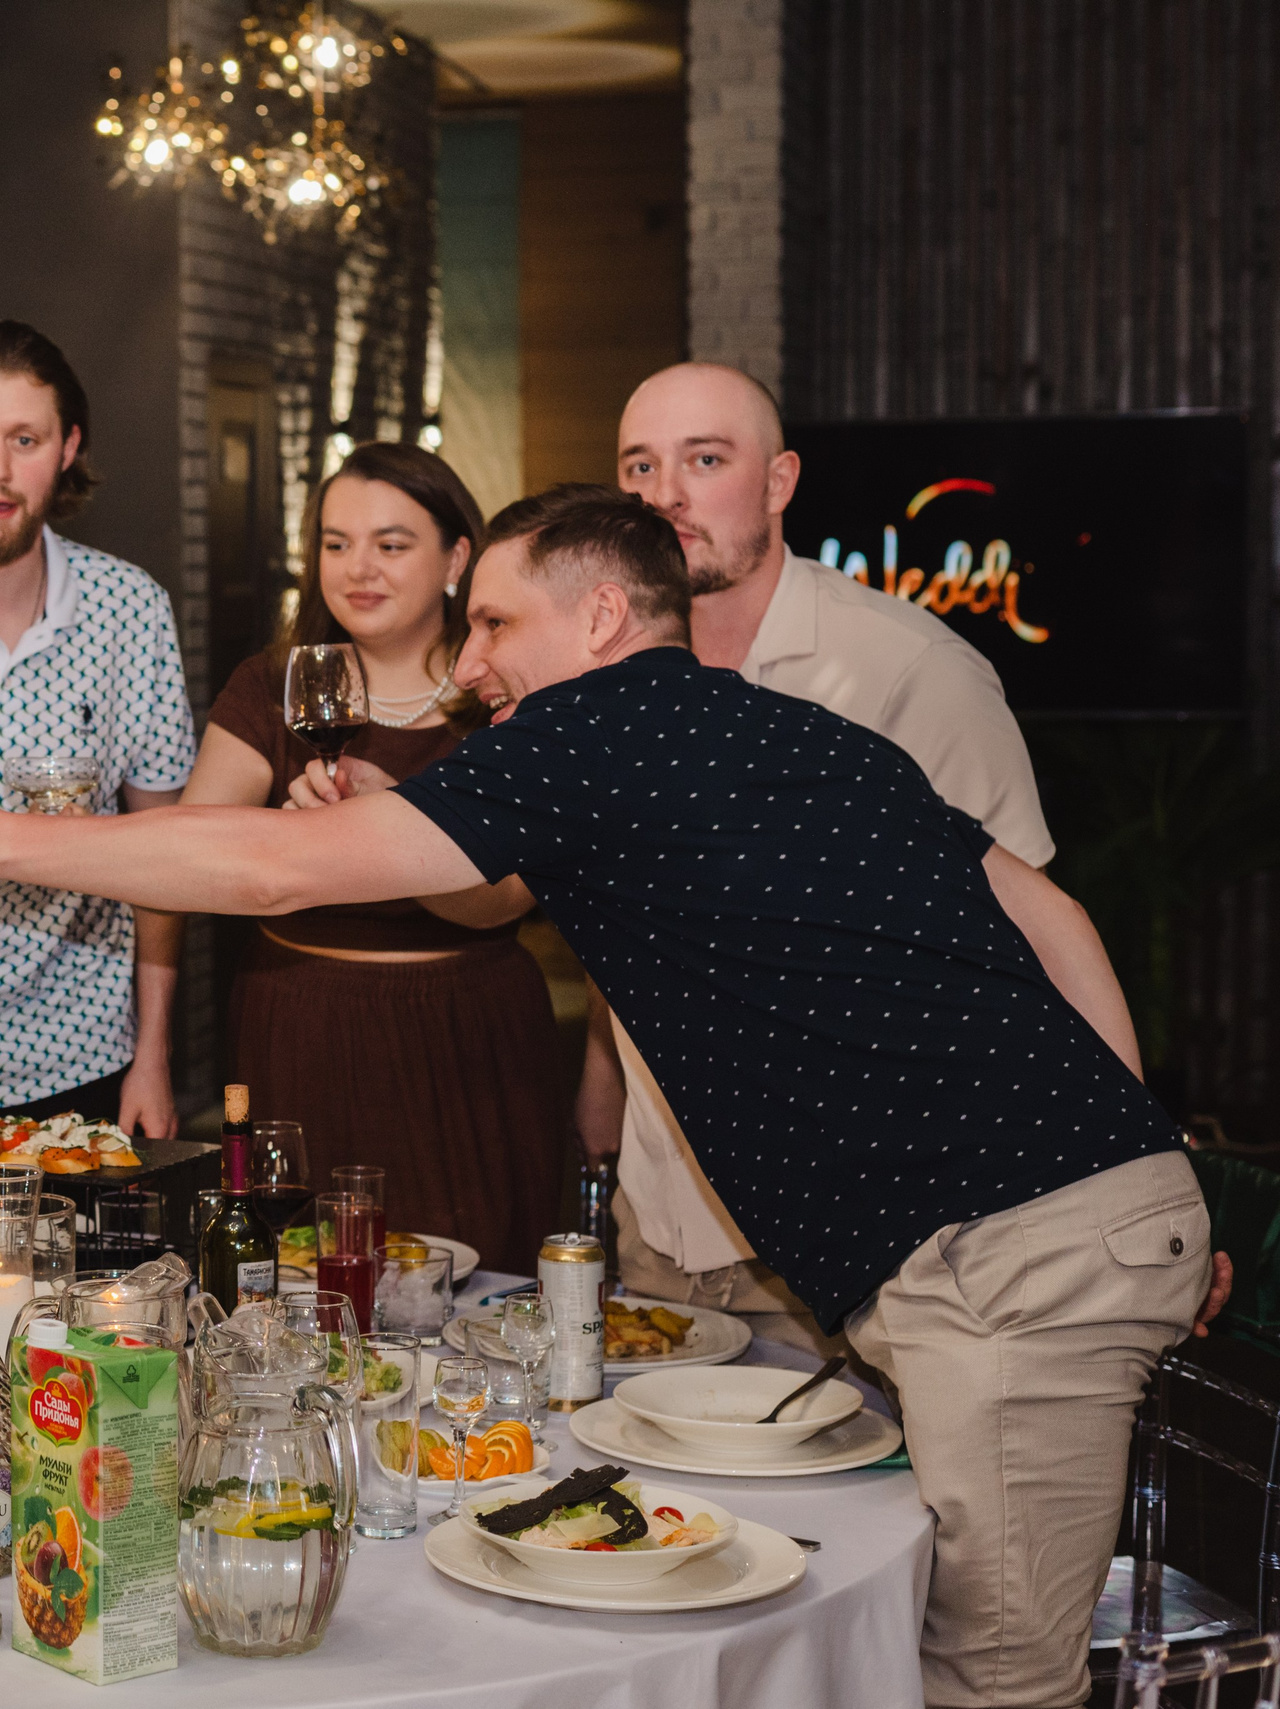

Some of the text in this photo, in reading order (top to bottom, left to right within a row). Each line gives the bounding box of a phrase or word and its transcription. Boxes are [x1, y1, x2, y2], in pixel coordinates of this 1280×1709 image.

[44, 1391, 70, 1413] Сады
[34, 1400, 79, 1429] Придонья
[39, 1454, 72, 1476] МУЛЬТИ
[42, 1468, 69, 1487] ФРУКТ
